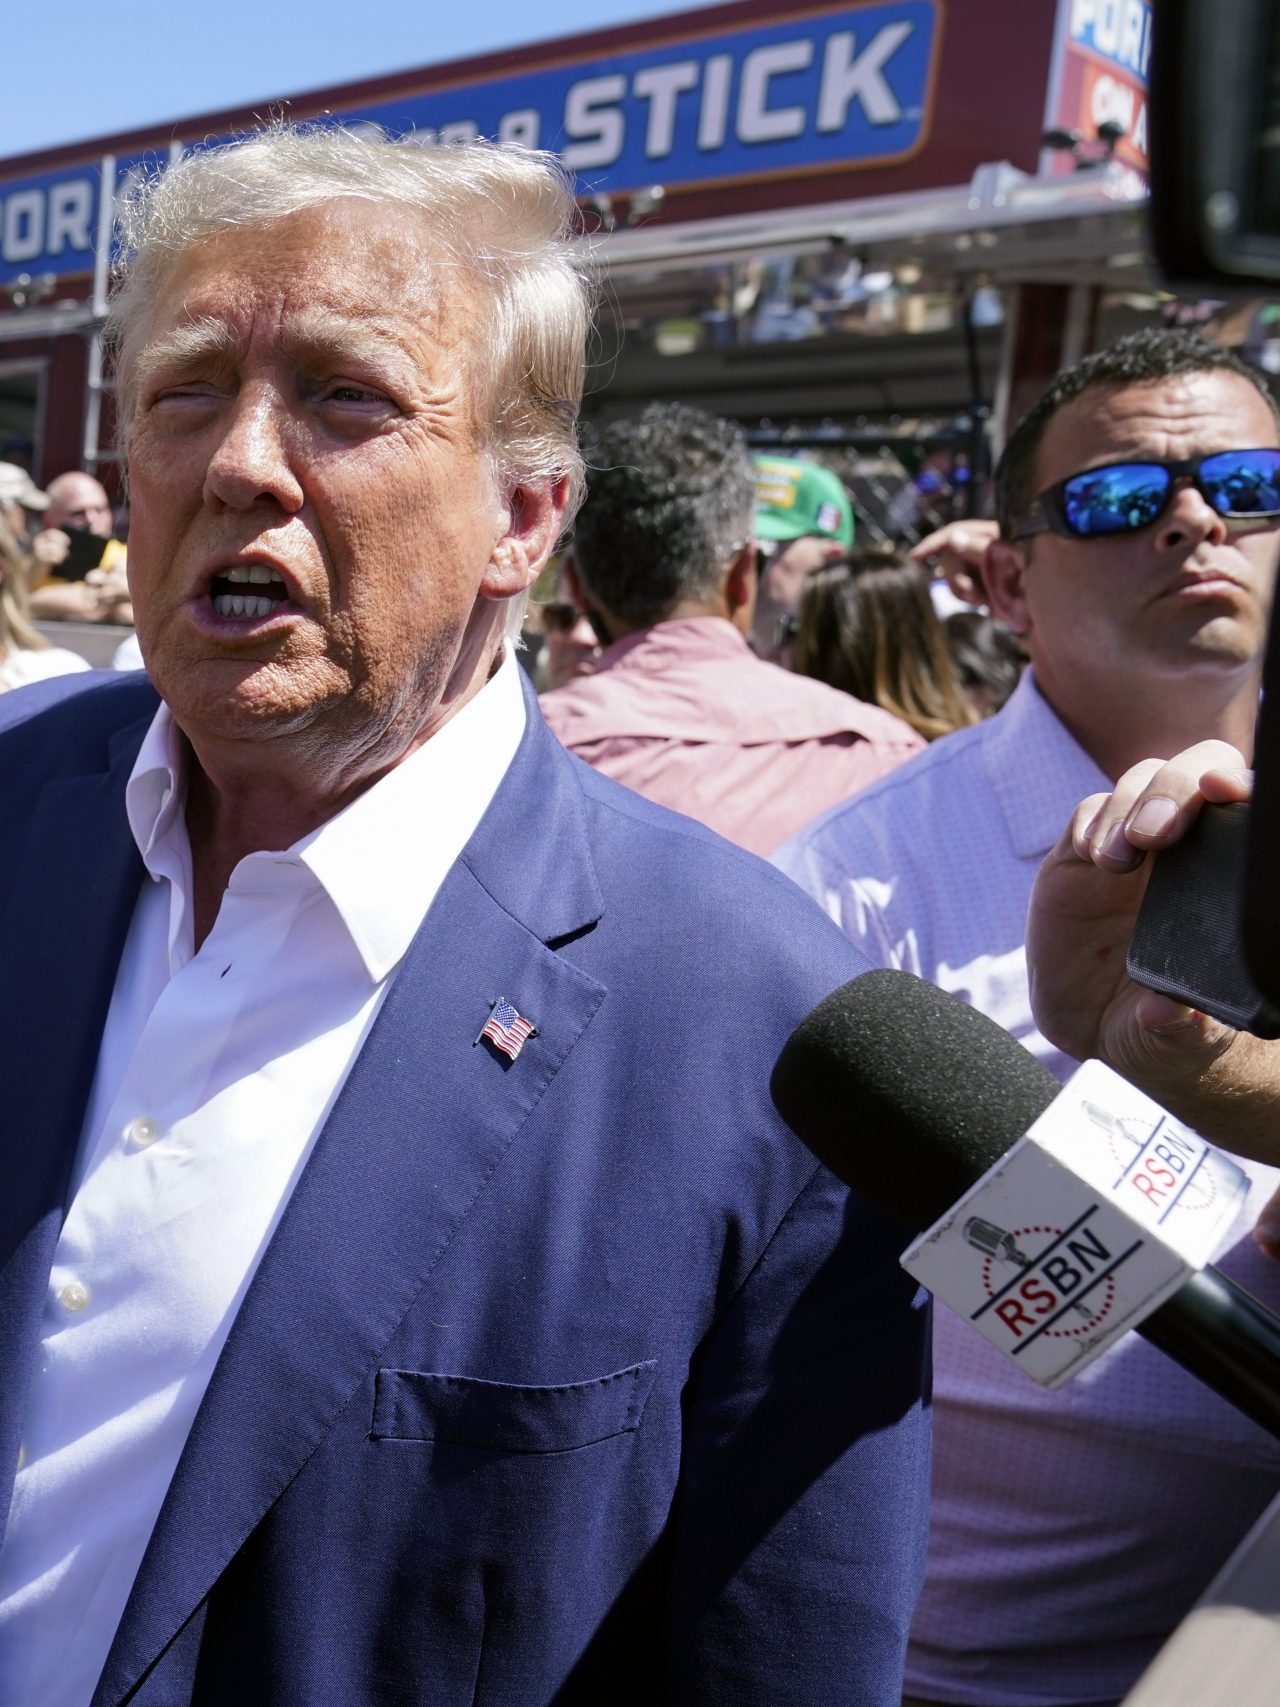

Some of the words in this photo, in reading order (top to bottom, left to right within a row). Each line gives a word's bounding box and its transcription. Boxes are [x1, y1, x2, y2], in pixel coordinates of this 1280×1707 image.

[1070, 0, 1152, 79] POR
[562, 19, 914, 171] STICK
[1131, 1127, 1196, 1207] RSBN
[994, 1227, 1112, 1338] RSBN
